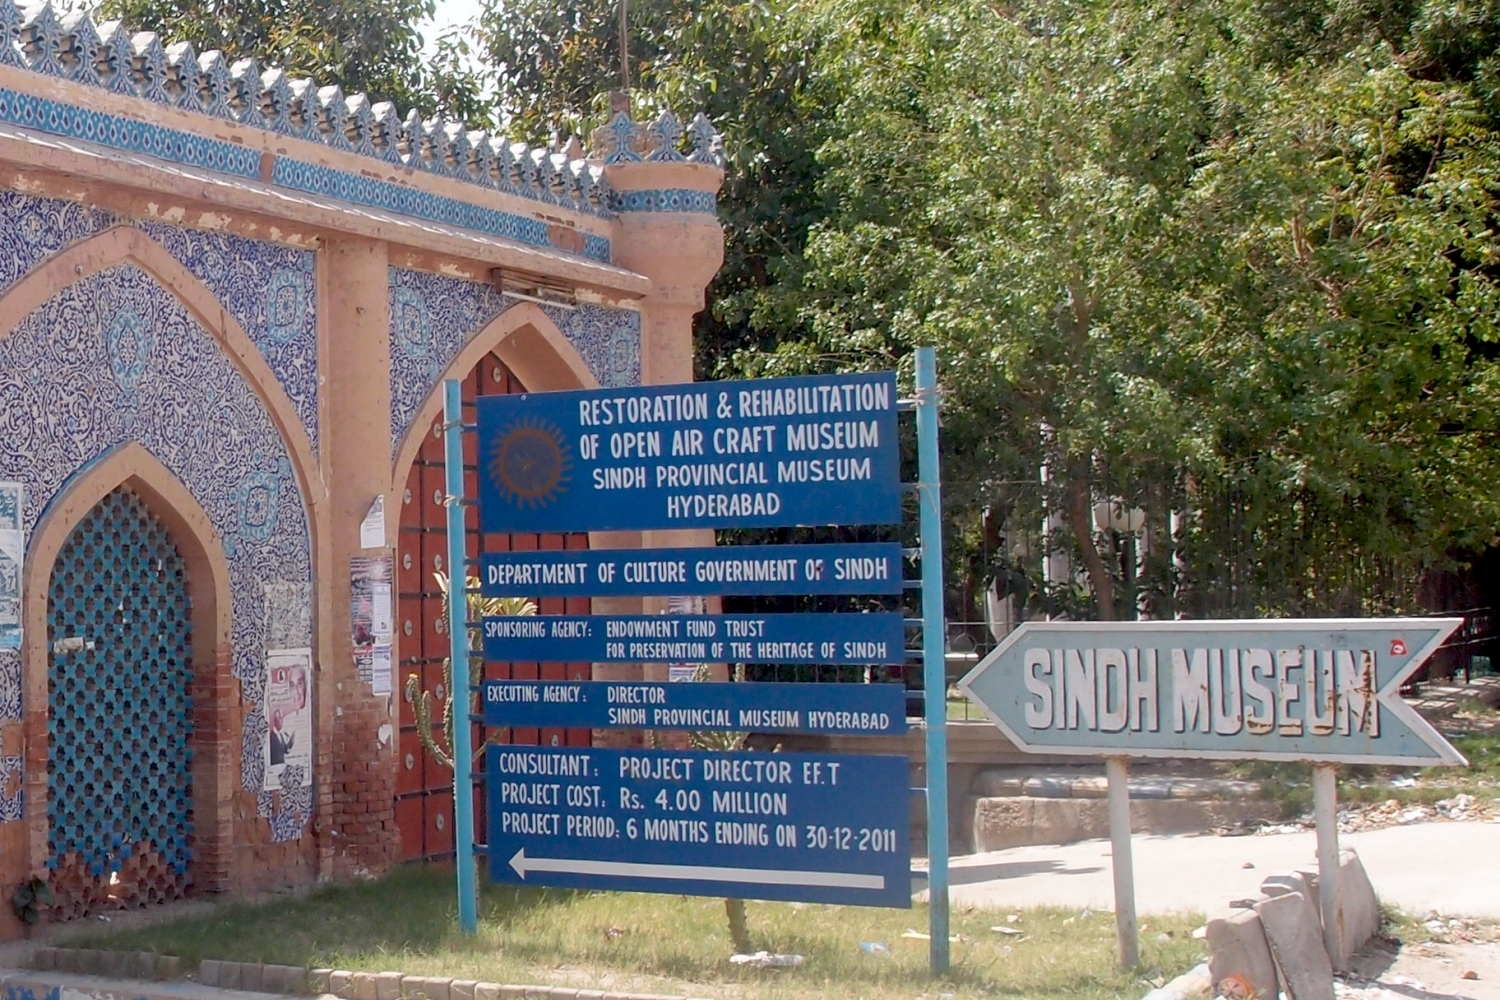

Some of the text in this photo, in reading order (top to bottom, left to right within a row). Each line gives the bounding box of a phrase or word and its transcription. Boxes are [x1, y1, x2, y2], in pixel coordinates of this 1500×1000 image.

[580, 383, 888, 425] RESTORATION & REHABILITATION
[581, 421, 878, 459] OF OPEN AIR CRAFT MUSEUM
[593, 458, 870, 489] SINDH PROVINCIAL MUSEUM
[668, 493, 780, 517] HYDERABAD
[489, 558, 887, 584] DEPARTMENT OF CULTURE GOVERNMENT OF SINDH
[486, 622, 545, 637] SPONSORING
[607, 621, 679, 637] ENDOWMENT
[687, 621, 715, 636] FUND
[725, 621, 764, 636] TRUST
[607, 642, 886, 658] FOR PRESERVATION OF THE HERITAGE OF SINDH
[488, 686, 538, 701] EXECUTING
[608, 687, 665, 703] DIRECTOR
[1023, 648, 1379, 738] SINDH MUSEUM
[609, 708, 889, 729] SINDH PROVINCIAL MUSEUM HYDERABAD
[620, 757, 693, 779] PROJECT
[704, 760, 791, 783] DIRECTOR
[503, 783, 560, 805] PROJECT
[621, 788, 644, 809] Rs.
[656, 790, 700, 811] 4.00
[713, 791, 786, 815] MILLION
[503, 812, 559, 834] PROJECT
[627, 818, 637, 838] 6
[645, 819, 708, 842] MONTHS
[716, 822, 768, 845] ENDING
[776, 825, 796, 847] ON
[807, 826, 895, 852] 30-12-2011
